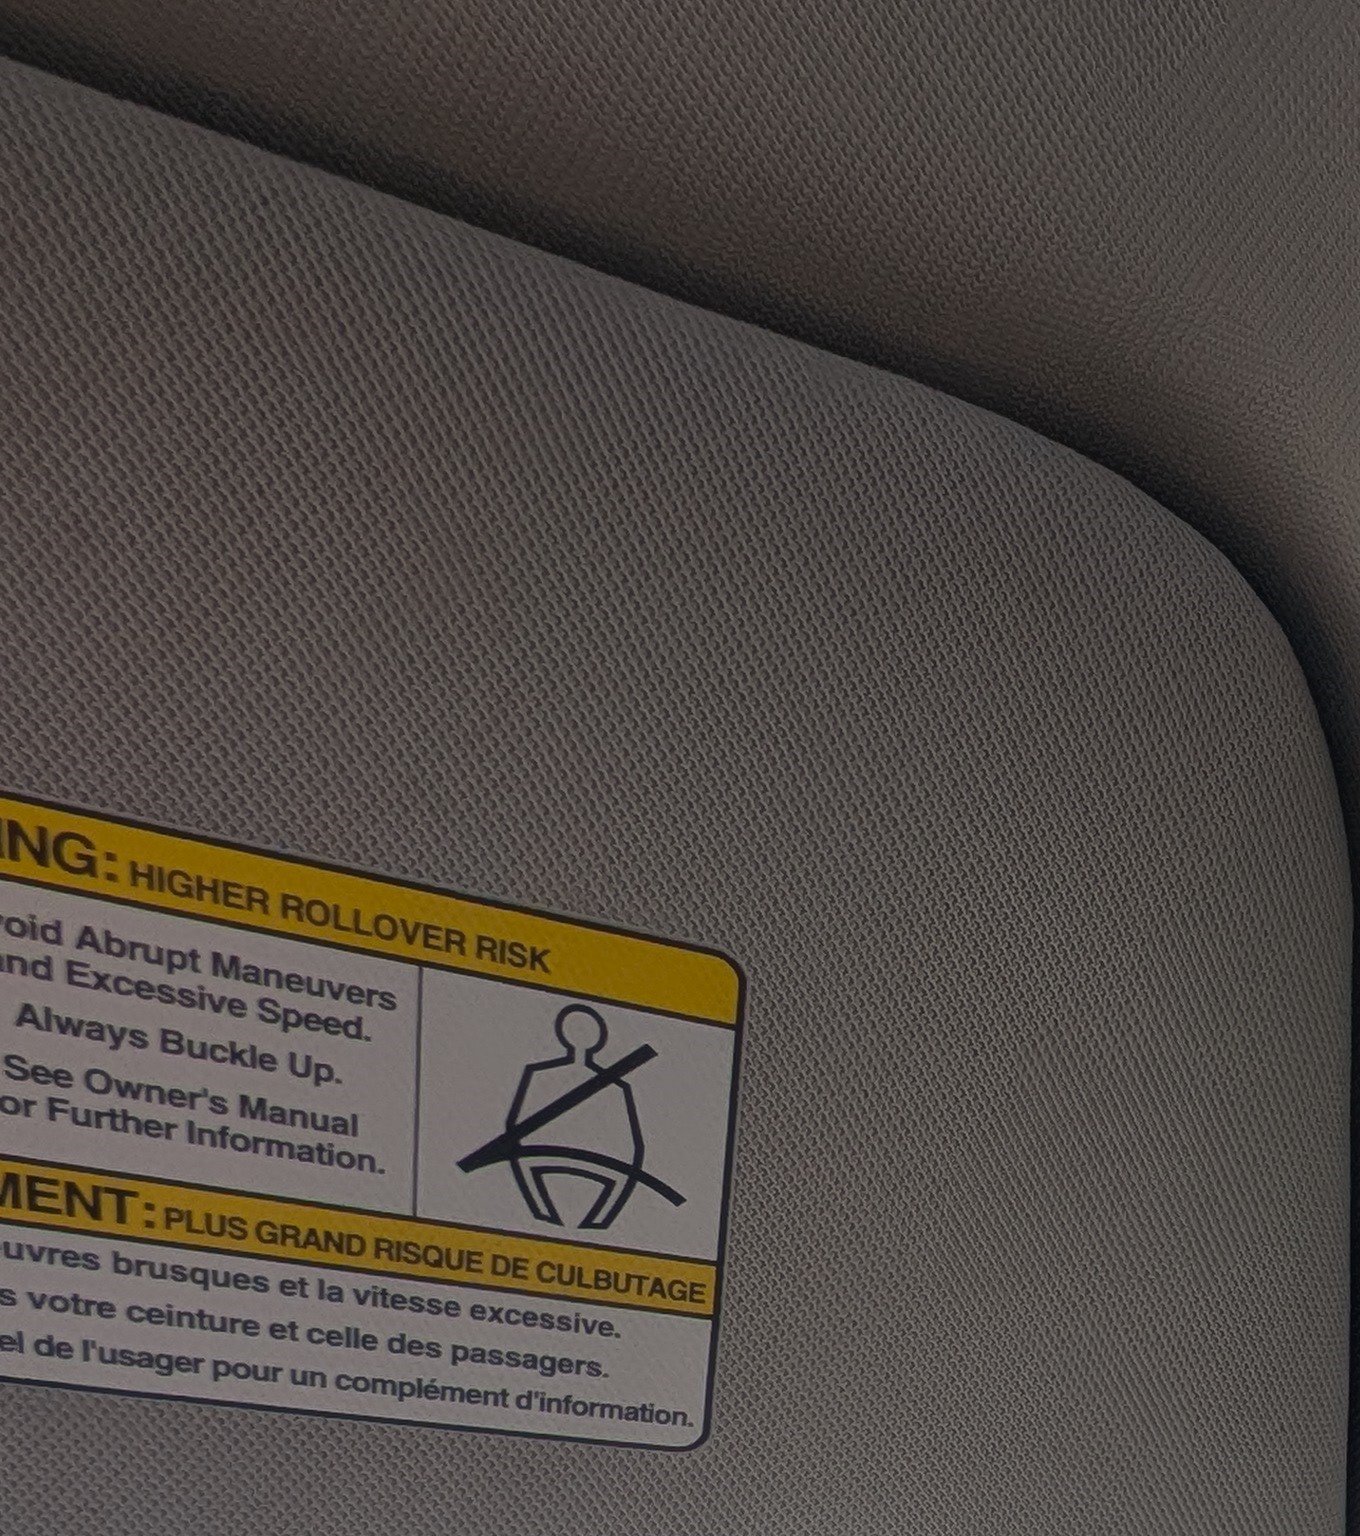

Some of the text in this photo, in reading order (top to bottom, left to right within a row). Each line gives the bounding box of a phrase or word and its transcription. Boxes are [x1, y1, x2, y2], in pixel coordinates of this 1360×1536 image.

[129, 860, 270, 915] HIGHER
[280, 891, 466, 957] ROLLOVER
[476, 935, 553, 974] RISK
[0, 914, 398, 1012] oid Abrupt Maneuvers
[0, 954, 372, 1043] nd Excessive Speed.
[15, 1002, 343, 1087] Always Buckle Up.
[4, 1055, 359, 1138] See Owner's Manual
[47, 1096, 178, 1141] Further
[187, 1120, 386, 1176] Information.
[112, 1250, 270, 1293] brusques
[279, 1277, 308, 1297] et
[318, 1279, 344, 1302] la
[353, 1285, 461, 1317] vitesse
[470, 1303, 621, 1338] excessive.
[164, 1207, 248, 1241] PLUS
[255, 1219, 366, 1258] GRAND
[374, 1235, 483, 1274] RISQUE
[491, 1254, 529, 1280] DE
[536, 1260, 706, 1304] CULBUTAGE
[26, 1290, 117, 1319] votre
[126, 1302, 260, 1338] ceinture
[269, 1320, 300, 1342] et
[306, 1327, 378, 1351] celle
[387, 1333, 442, 1359] des
[451, 1344, 610, 1378] passagers.
[33, 1334, 73, 1360] de
[82, 1338, 206, 1376] l'usager
[211, 1357, 283, 1382] pour
[291, 1369, 327, 1388] un
[335, 1373, 509, 1408] complément
[515, 1390, 694, 1428] d'information.
